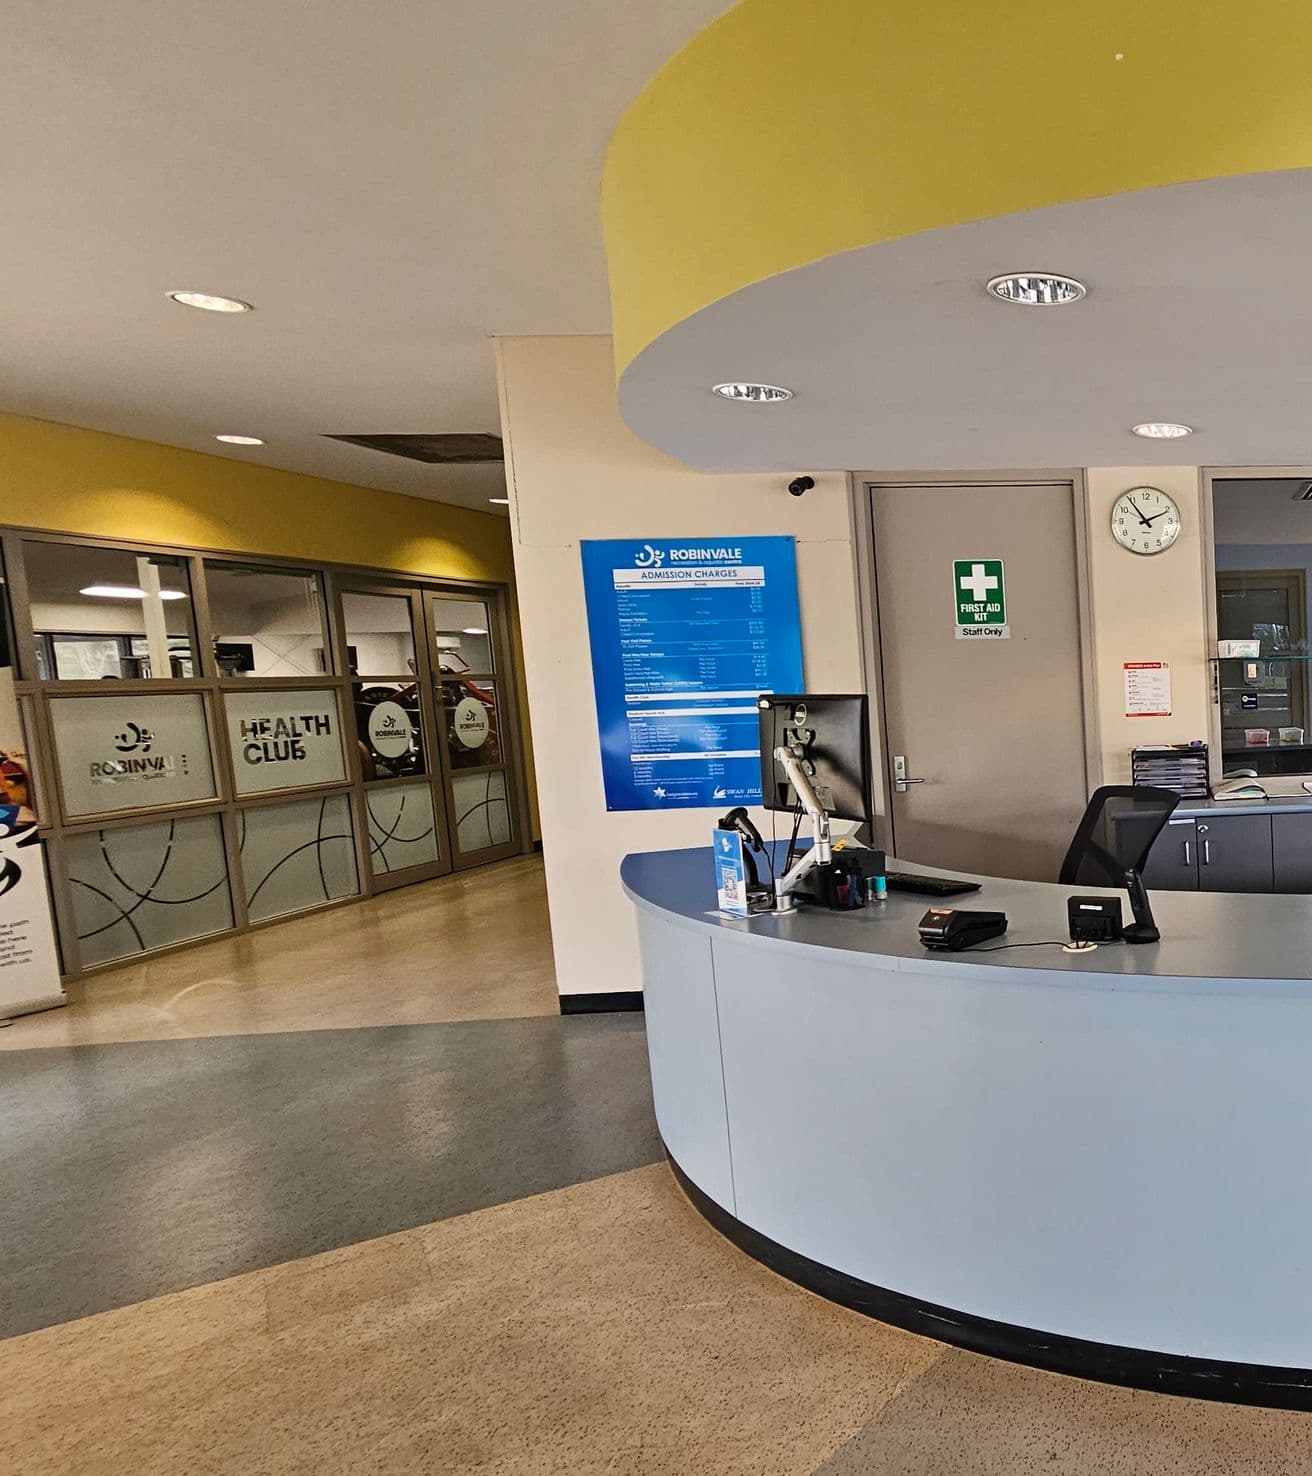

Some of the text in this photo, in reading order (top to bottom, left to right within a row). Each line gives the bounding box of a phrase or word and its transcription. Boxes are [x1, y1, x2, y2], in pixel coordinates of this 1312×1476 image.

[1142, 493, 1151, 501] 12
[1120, 506, 1129, 514] 10
[669, 548, 742, 560] ROBINVALE
[641, 569, 738, 580] ADMISSION CHARGES
[960, 603, 1001, 613] FIRST AID
[974, 612, 988, 621] KIT
[962, 627, 1003, 637] Staff Only
[240, 714, 331, 739] HEALTH
[243, 739, 307, 765] CLUB
